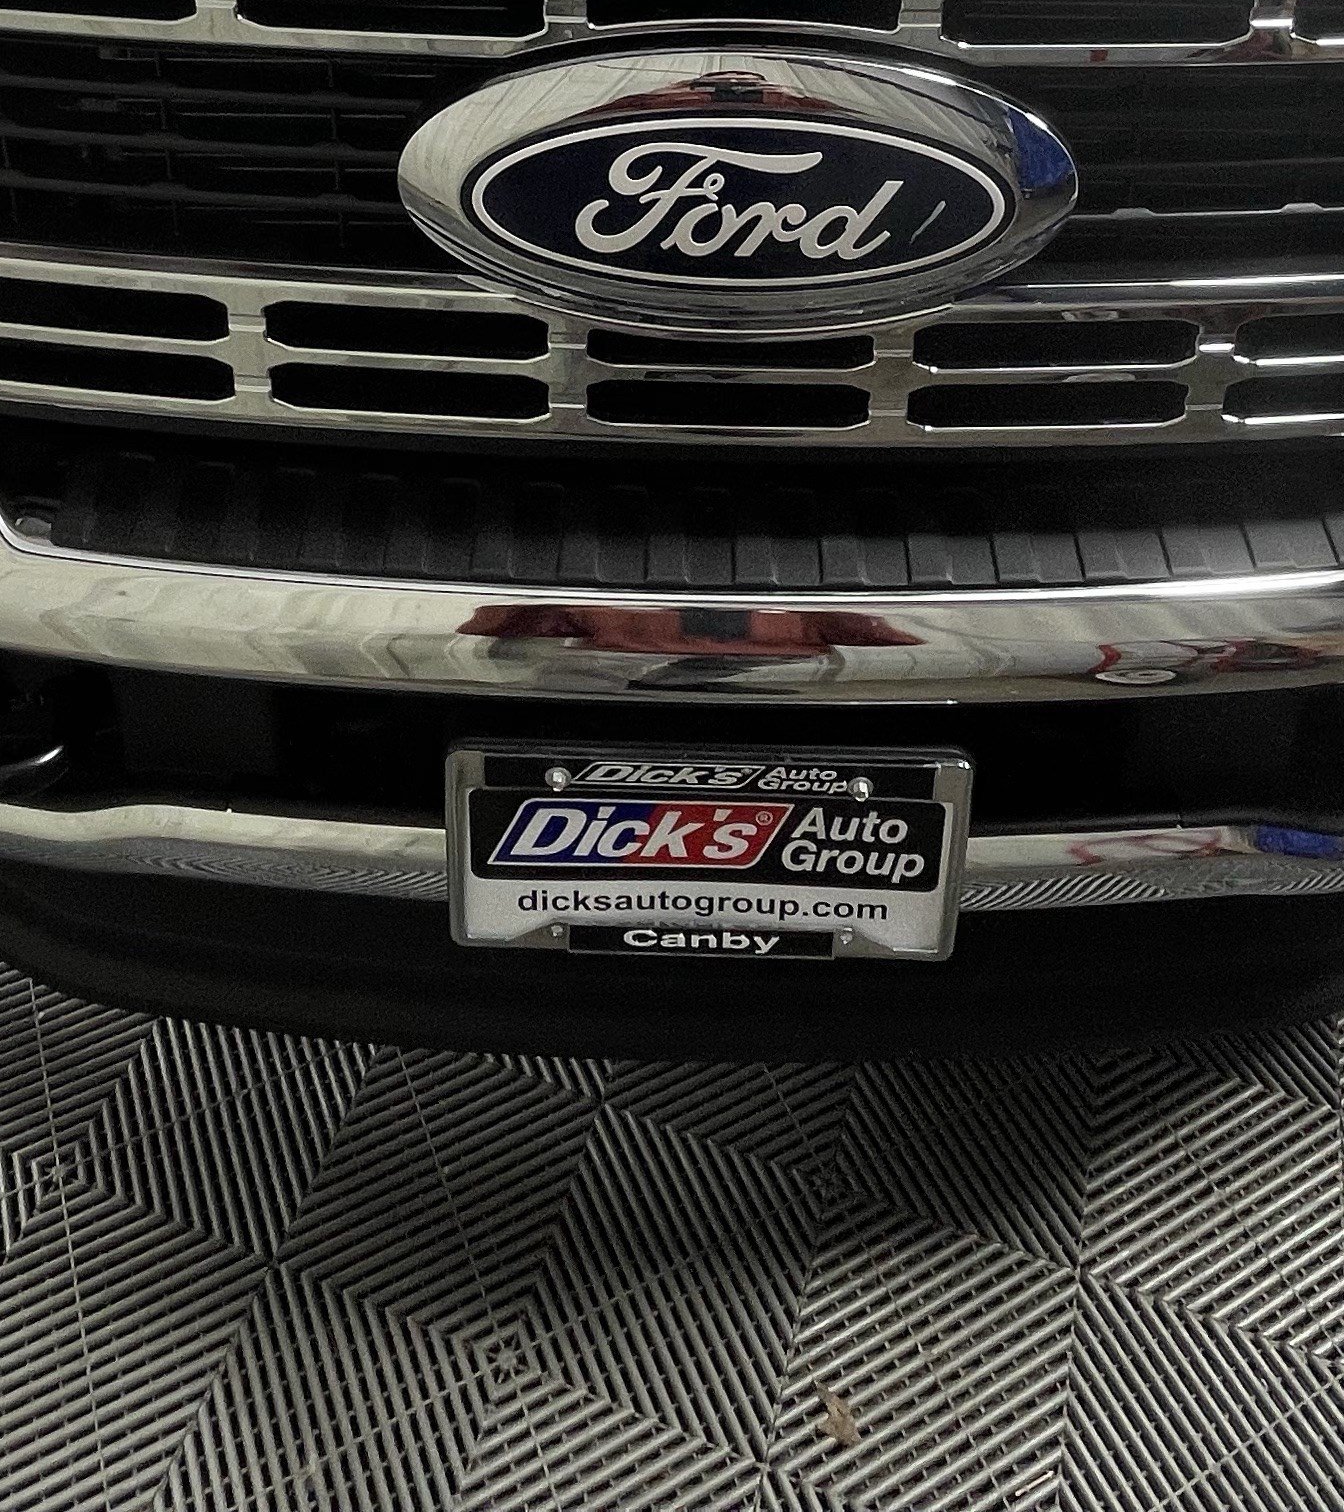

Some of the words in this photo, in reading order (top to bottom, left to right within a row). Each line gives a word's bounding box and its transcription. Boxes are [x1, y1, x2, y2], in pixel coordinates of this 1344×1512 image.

[574, 141, 905, 260] Ford
[757, 778, 849, 794] Group
[763, 766, 838, 781] Auto
[791, 807, 909, 844] Auto
[781, 839, 925, 883] Group
[517, 890, 888, 921] dicksautogroup.com
[622, 929, 780, 955] Canby
